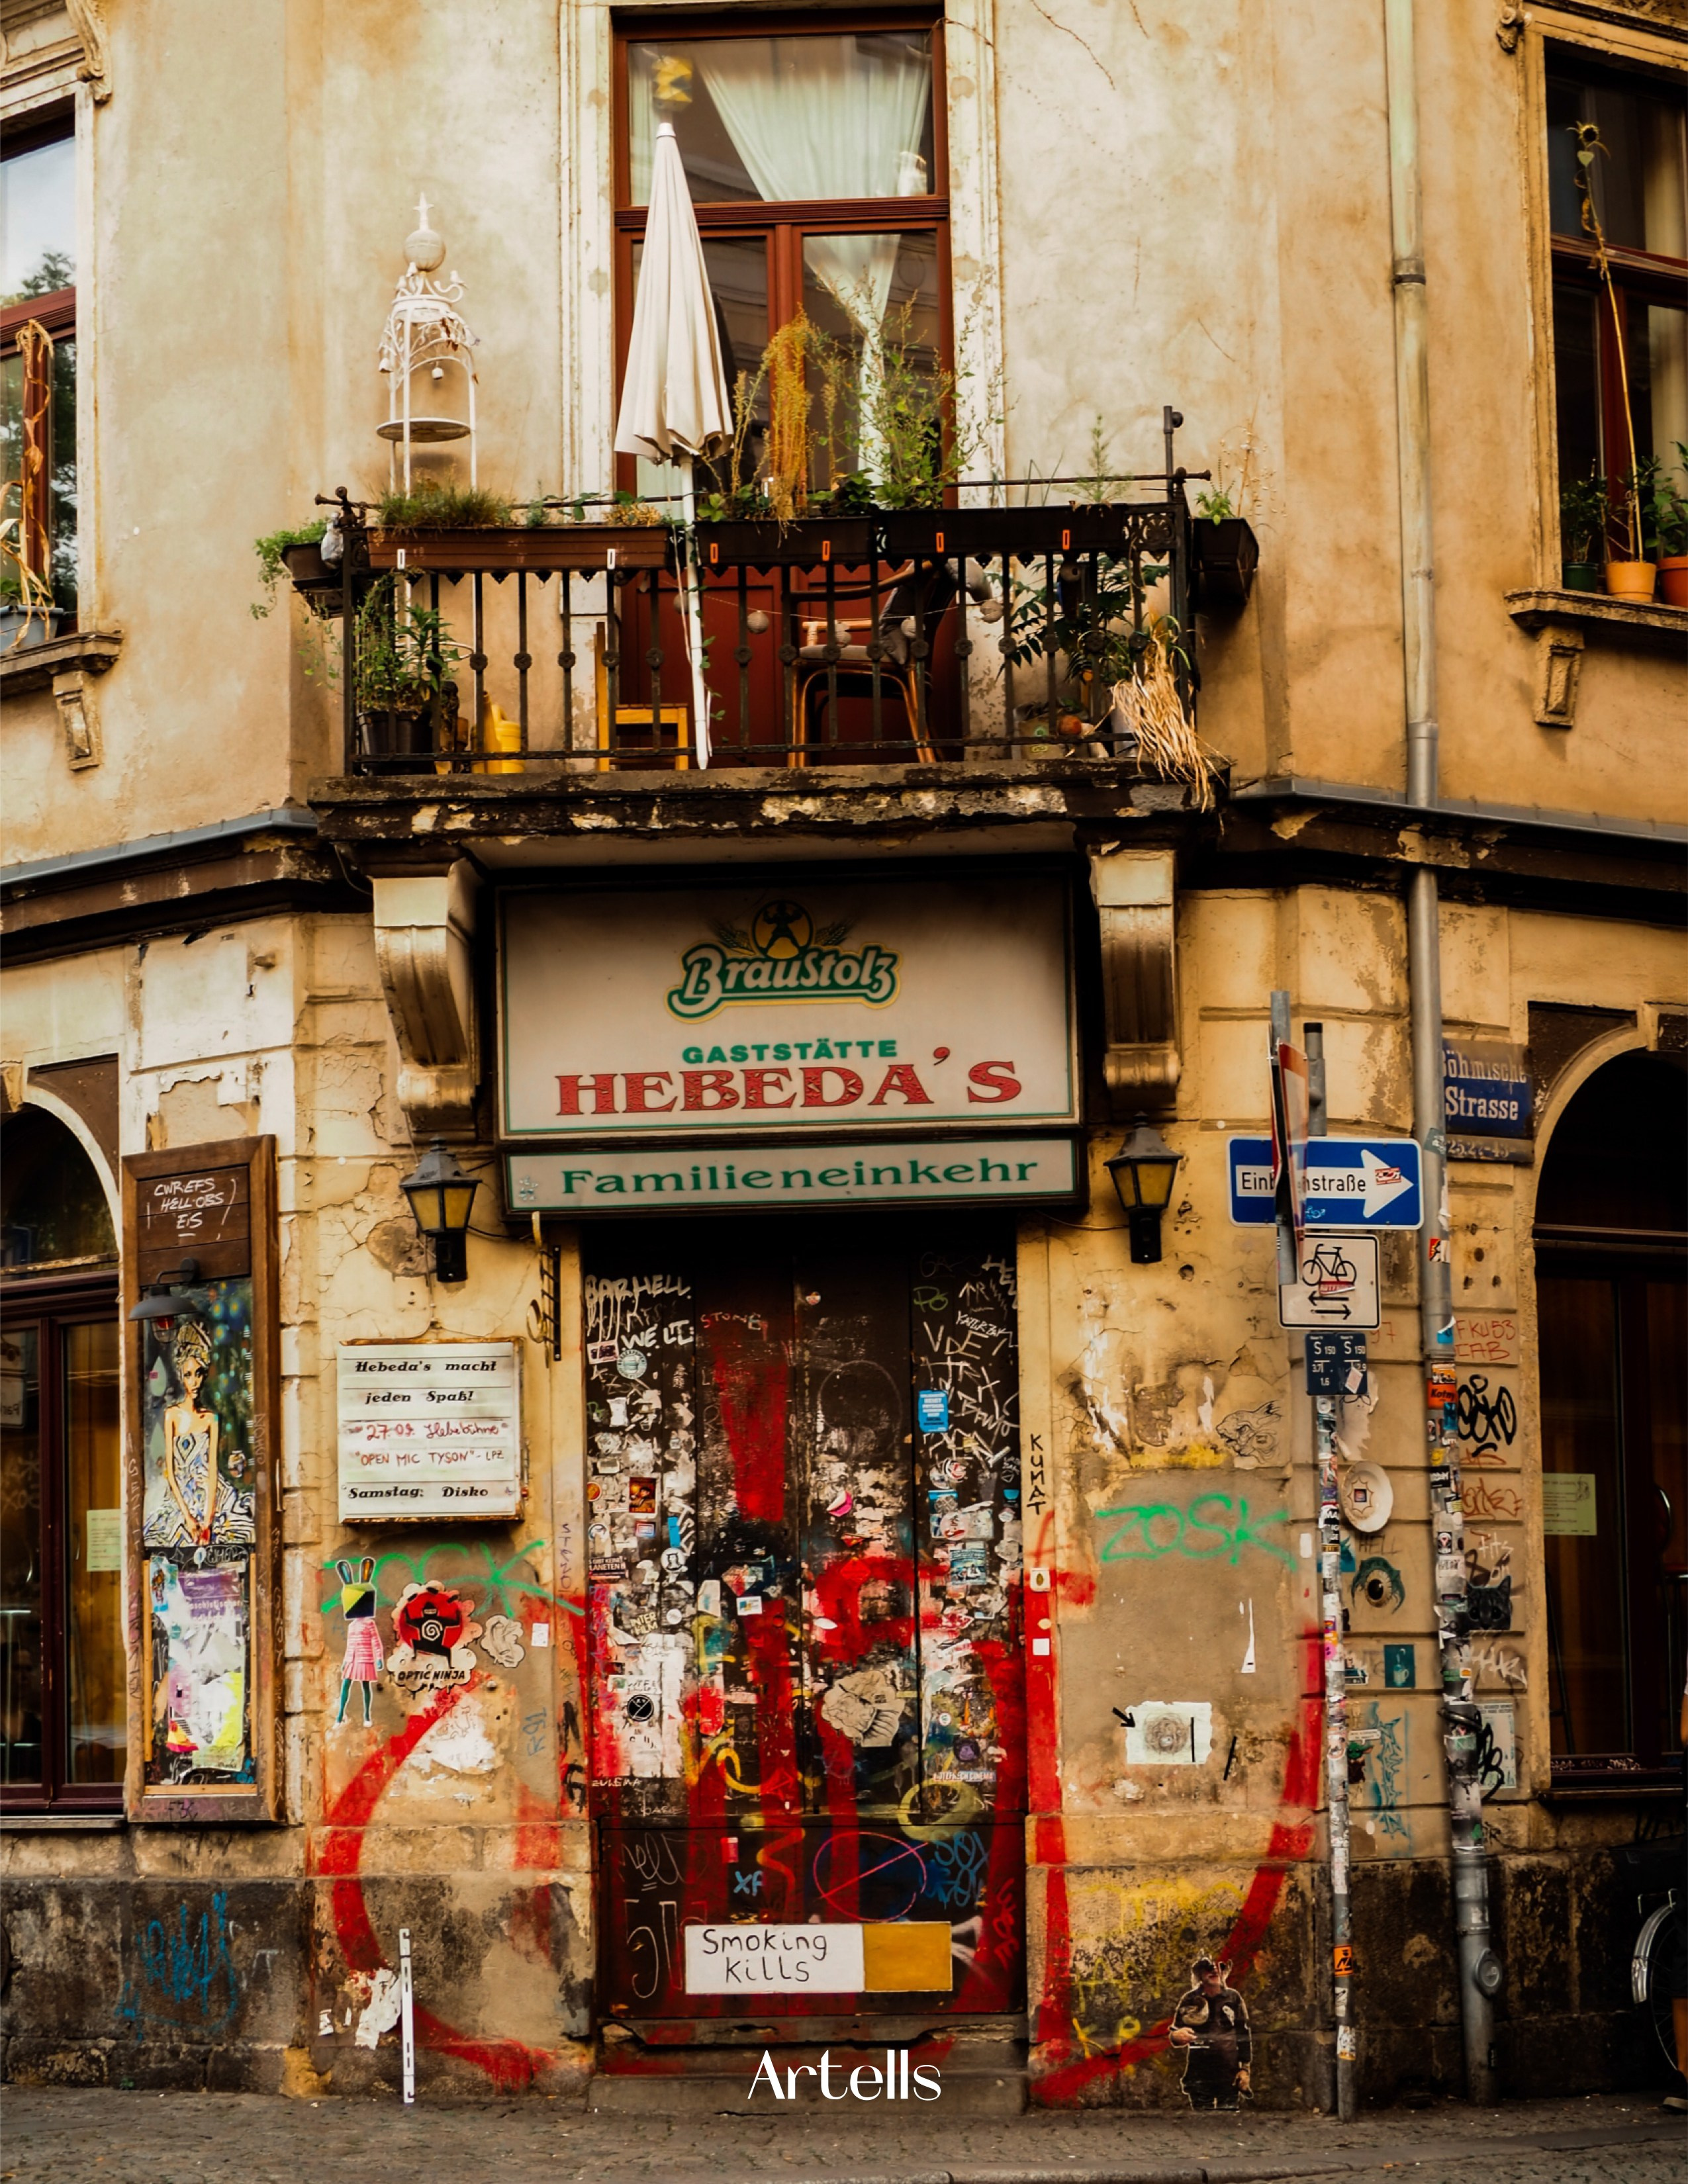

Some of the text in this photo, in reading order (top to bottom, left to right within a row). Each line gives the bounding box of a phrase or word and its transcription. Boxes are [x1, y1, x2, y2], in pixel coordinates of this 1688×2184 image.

[682, 1039, 898, 1064] GASTSTÄTTE
[555, 1046, 1022, 1116] HEBEDA'S
[1445, 1086, 1519, 1120] Strasse
[562, 1158, 1039, 1195] Familieneinkehr
[1313, 1341, 1322, 1355] S
[1344, 1341, 1352, 1355] S
[355, 1361, 496, 1372] Hebeda's macht
[365, 1390, 474, 1404] jeden Spaß!
[348, 1486, 489, 1499] Samstag: Disko
[398, 1670, 465, 1682] OPTIC NINJA
[702, 1928, 827, 1960] Smoking
